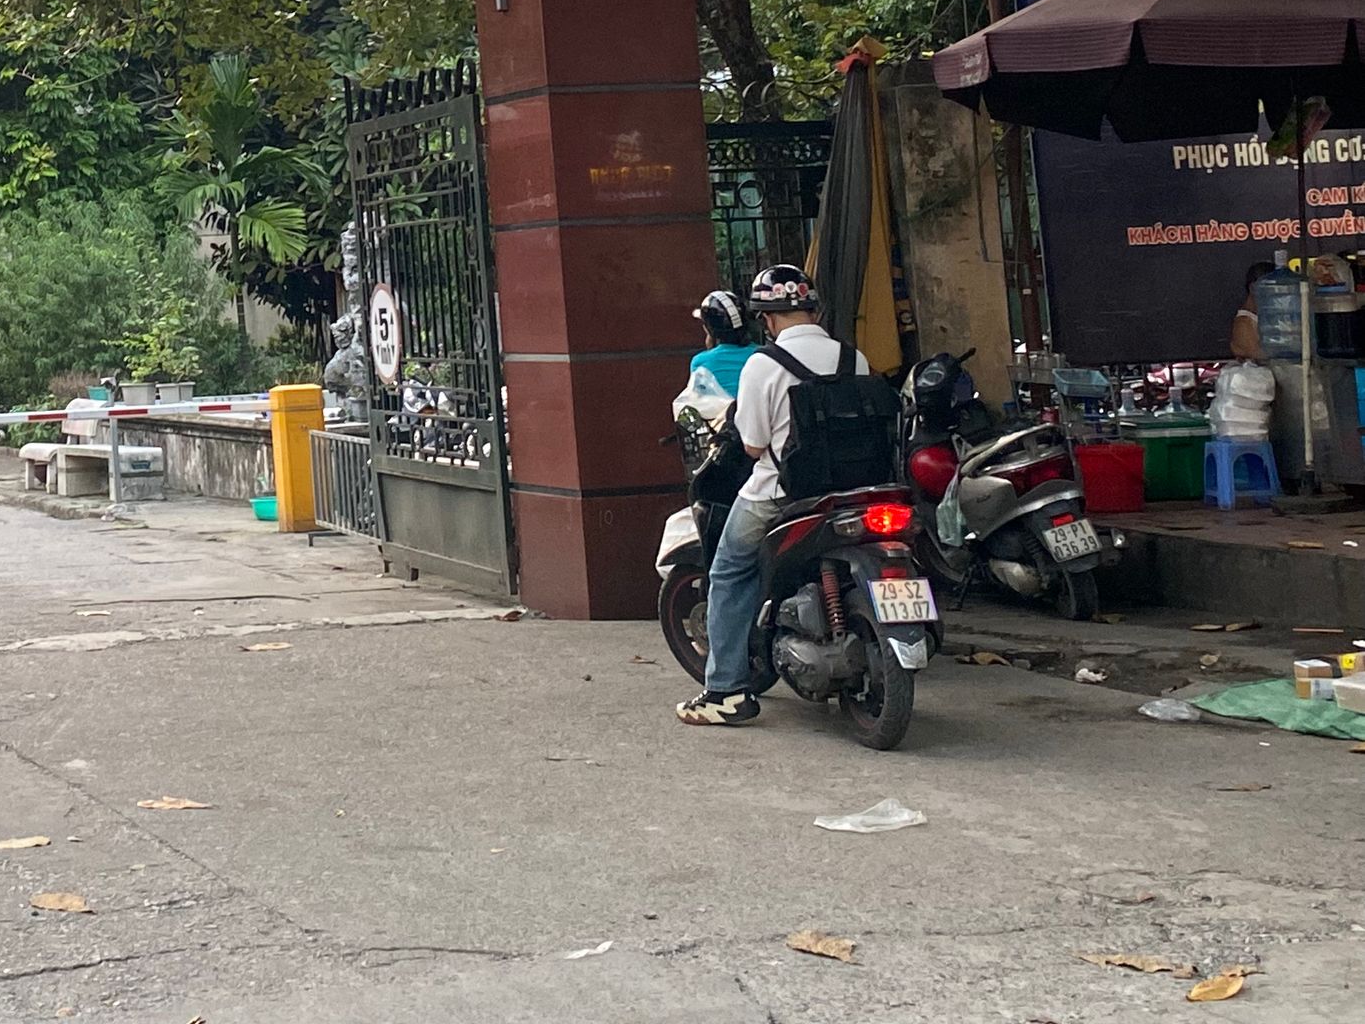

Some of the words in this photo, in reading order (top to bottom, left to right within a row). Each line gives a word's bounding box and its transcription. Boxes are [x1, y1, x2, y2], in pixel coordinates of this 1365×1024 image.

[1172, 143, 1229, 173] PHỤC
[1234, 134, 1270, 167] HỒI
[1306, 186, 1348, 207] CAM
[1127, 222, 1193, 246] KHÁCH
[1196, 219, 1250, 242] HÀNG
[1252, 218, 1301, 243] ĐƯỢC
[1307, 208, 1365, 237] QUYỀN
[378, 308, 389, 341] 5
[1051, 522, 1087, 543] 29-P1
[879, 581, 923, 600] 29-S2
[880, 601, 930, 620] 113.07
